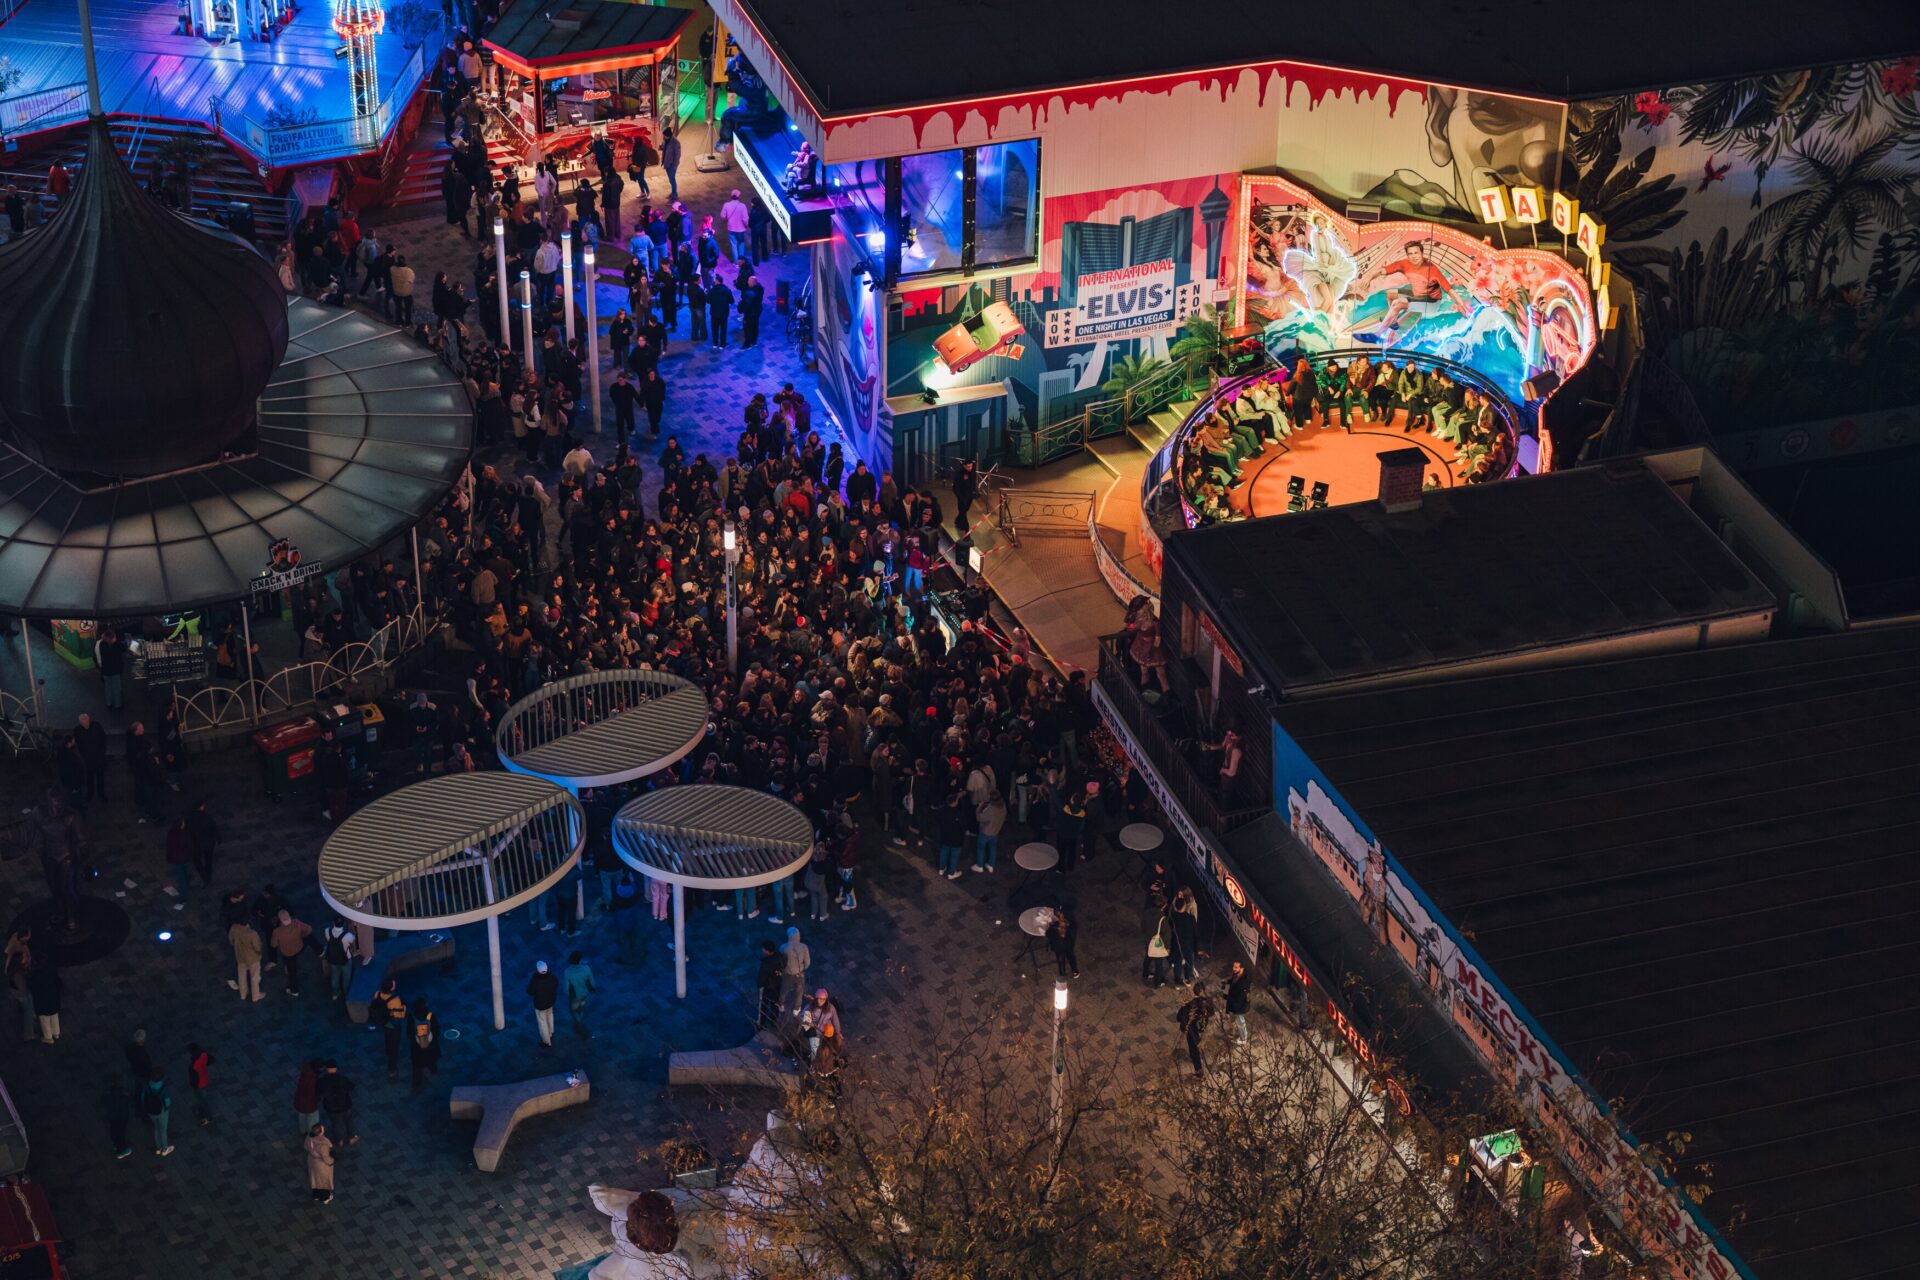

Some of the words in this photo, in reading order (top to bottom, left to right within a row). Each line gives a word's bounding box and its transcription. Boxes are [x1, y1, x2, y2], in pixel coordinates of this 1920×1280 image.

[269, 141, 300, 154] GRATIS
[303, 134, 344, 150] ABSTURZ
[271, 127, 338, 145] FREIFALLTURM
[751, 165, 767, 195] REALITY
[1078, 258, 1174, 288] INTERNATIONAL
[1109, 280, 1138, 291] PRESENTS
[1087, 283, 1164, 319] ELVIS
[1049, 313, 1059, 345] NOW
[1074, 333, 1113, 344] INTERNATIONAL
[1114, 330, 1130, 338] HOTEL
[1131, 325, 1158, 335] PRESENTS
[1158, 322, 1172, 331] ELVIS
[1078, 326, 1094, 336] ONE
[1095, 323, 1117, 333] NIGHT
[1118, 321, 1126, 329] IN
[1128, 318, 1142, 328] LAS
[1144, 312, 1168, 324] VEGAS
[293, 562, 322, 578] DRINK
[1097, 694, 1128, 746] MEISTER
[1161, 791, 1167, 804] &
[1168, 800, 1196, 847] LEMON
[1251, 902, 1312, 988] WIENER
[1456, 958, 1559, 1084] MECKY
